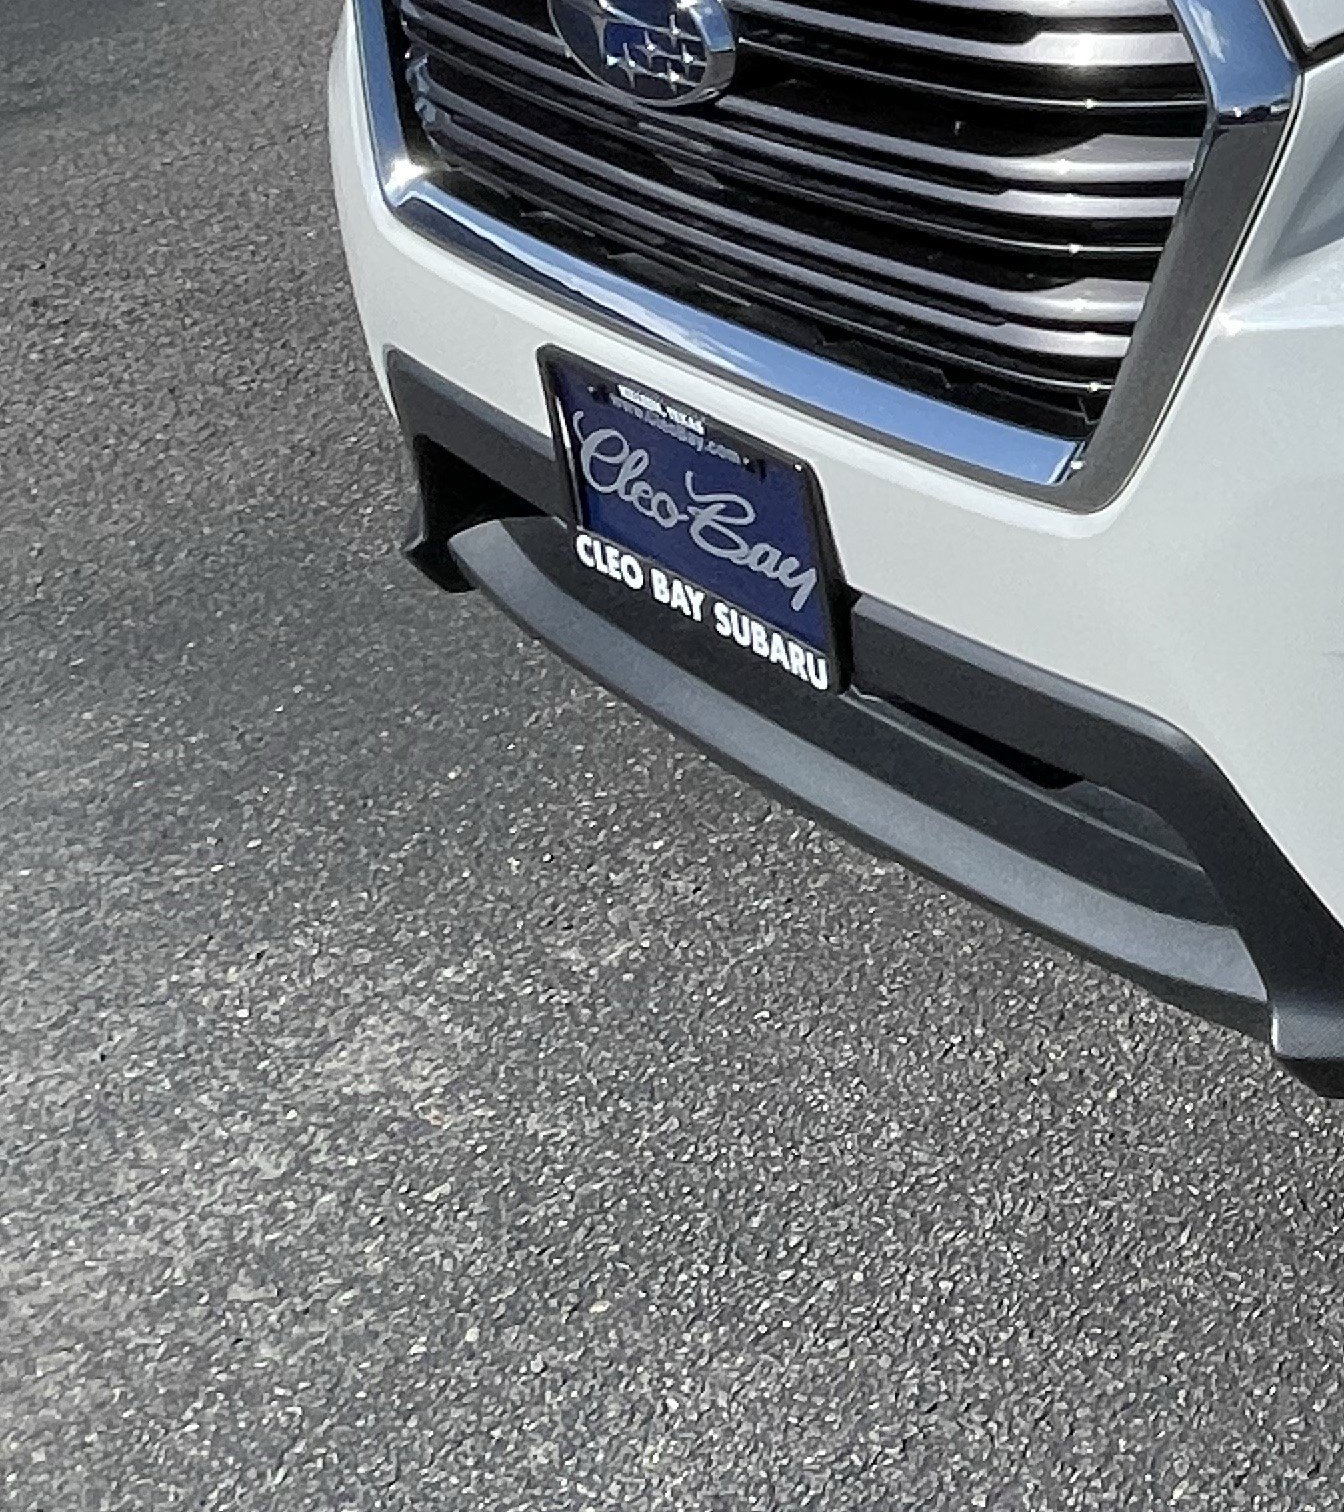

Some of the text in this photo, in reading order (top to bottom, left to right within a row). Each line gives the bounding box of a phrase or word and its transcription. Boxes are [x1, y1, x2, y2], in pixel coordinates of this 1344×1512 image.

[572, 410, 818, 611] Cleo Bay
[575, 533, 829, 690] CLEO BAY SUBARU
